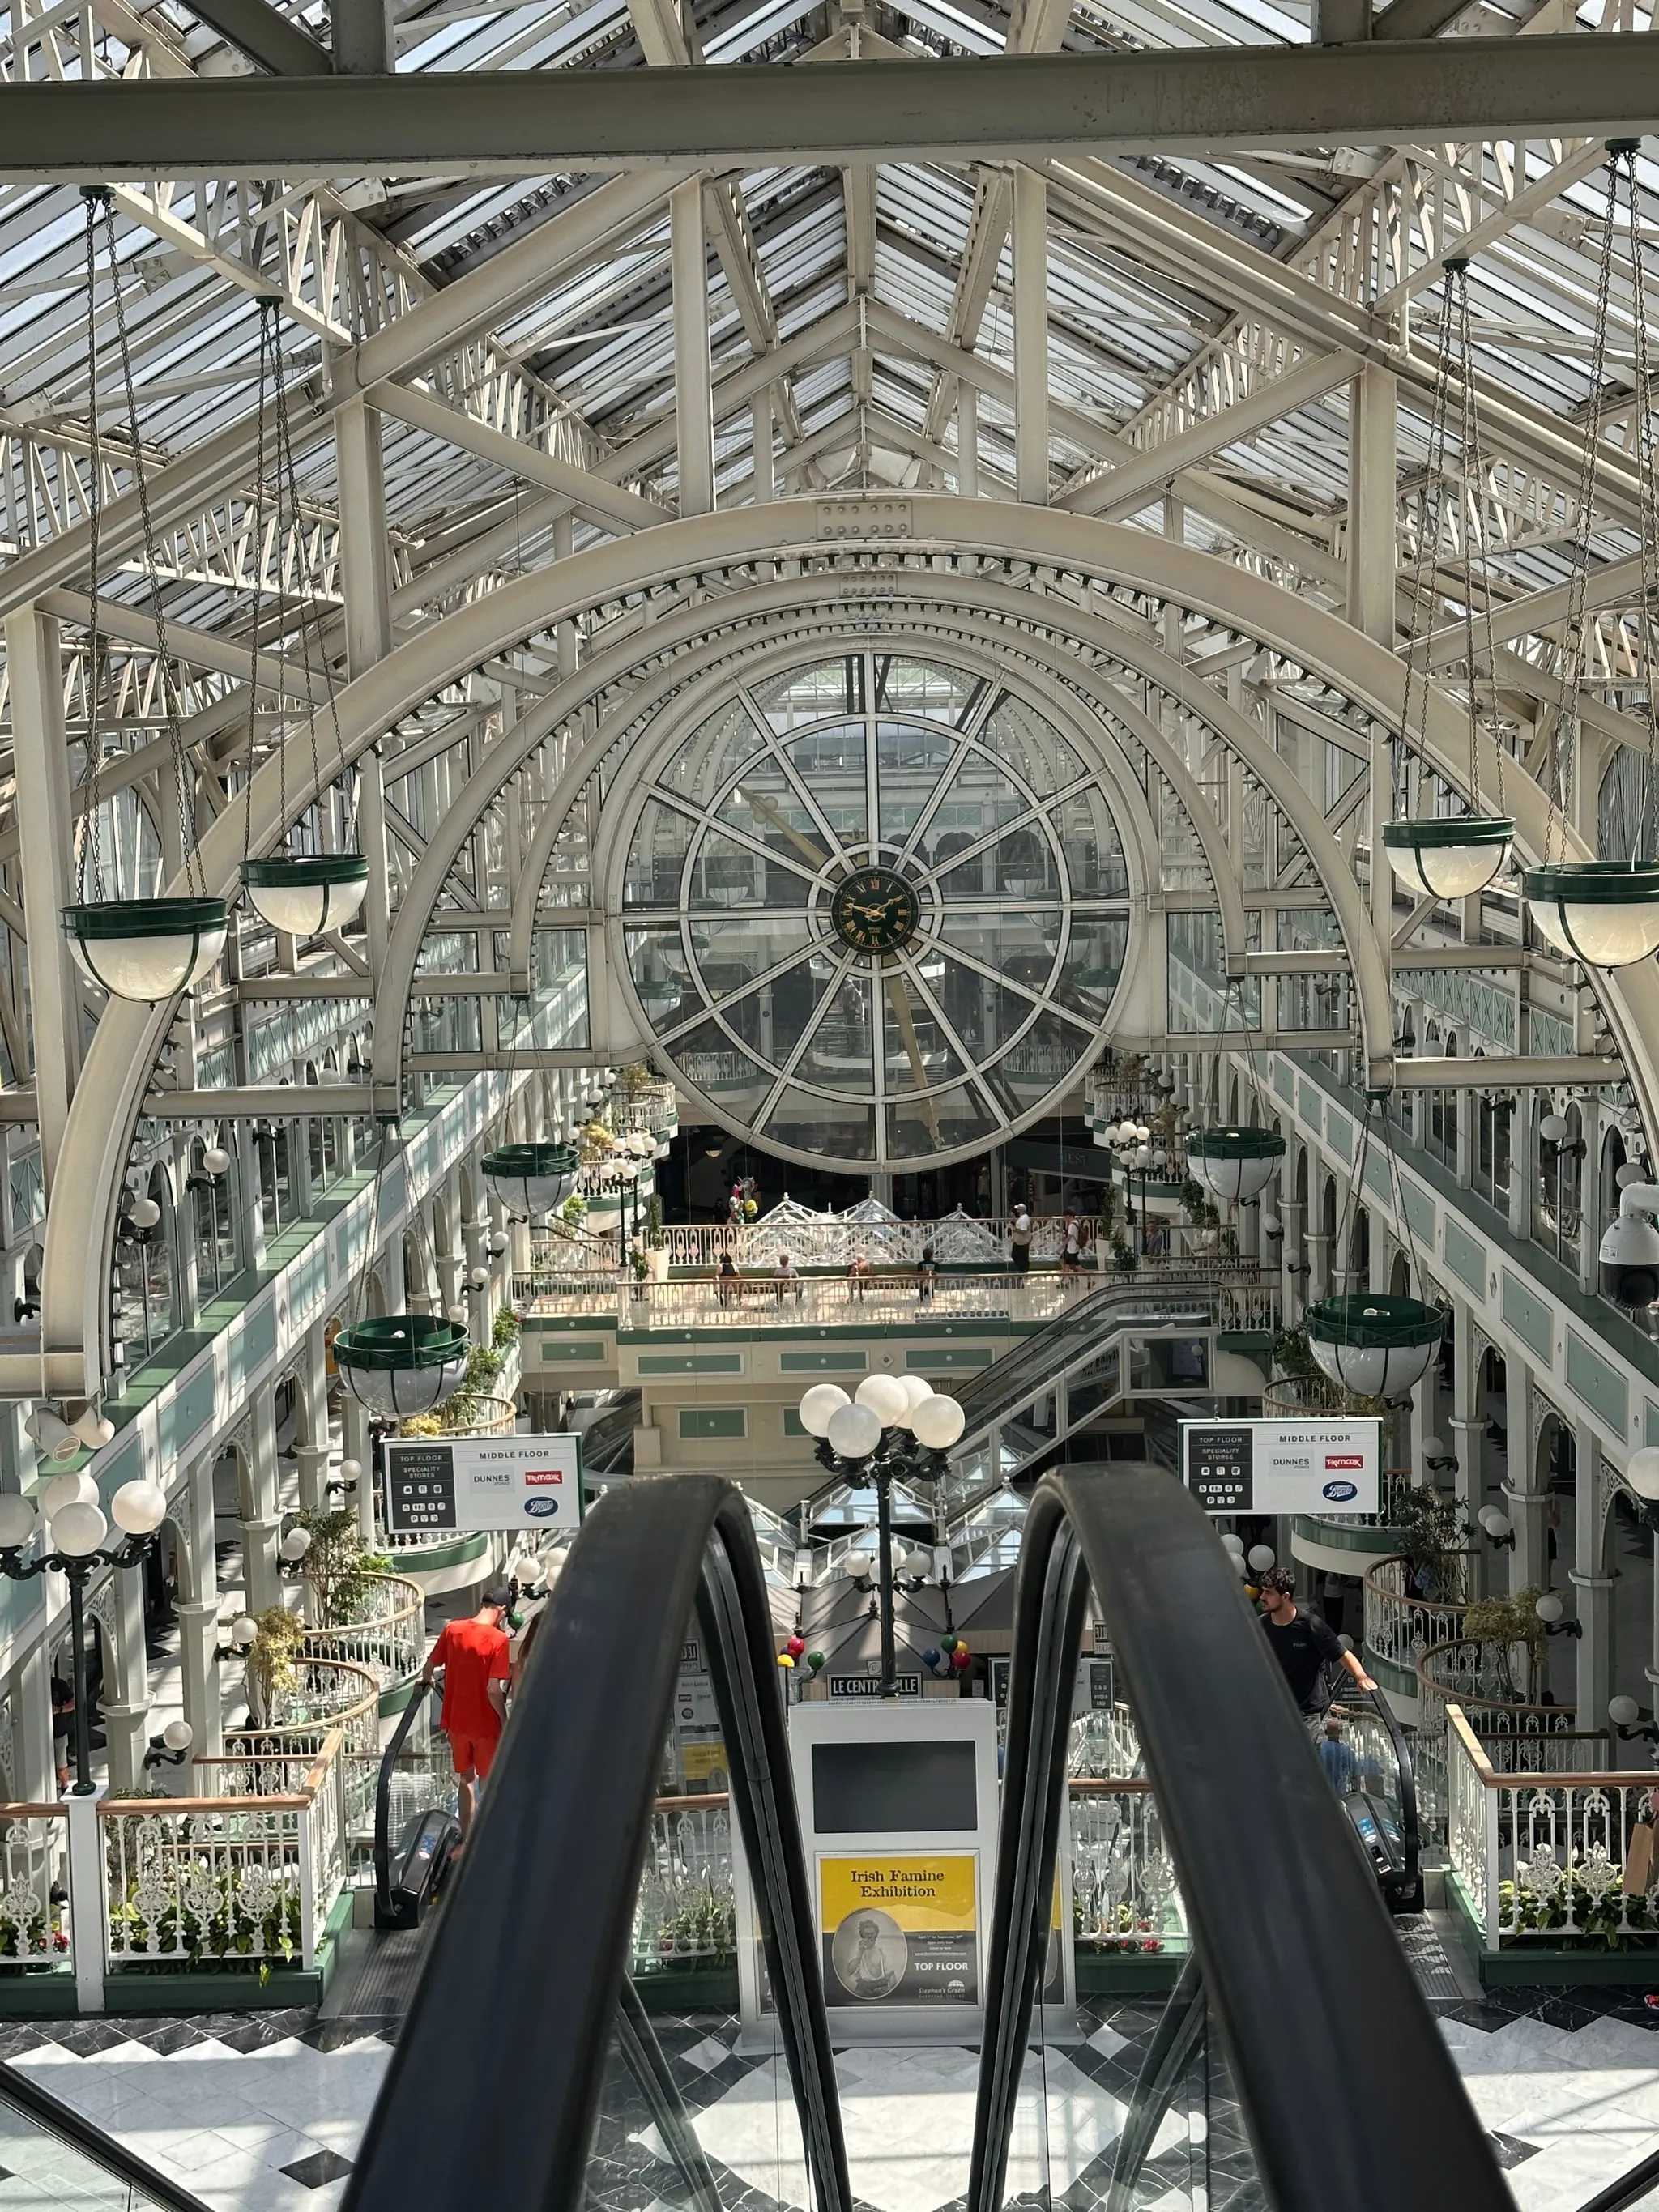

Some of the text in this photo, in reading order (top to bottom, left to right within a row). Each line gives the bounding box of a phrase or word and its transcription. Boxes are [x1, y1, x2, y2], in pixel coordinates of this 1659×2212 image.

[1279, 1434, 1316, 1443] MIDDLE
[479, 1450, 549, 1460] MIDDLE FLOOR
[1273, 1458, 1310, 1466] DUNNES
[473, 1474, 510, 1483] DUNNES
[833, 1680, 844, 1694] LE
[851, 1869, 945, 1883] Irish Famine
[860, 1886, 936, 1899] Exhibition
[914, 1962, 969, 1971] TOP FLOOR
